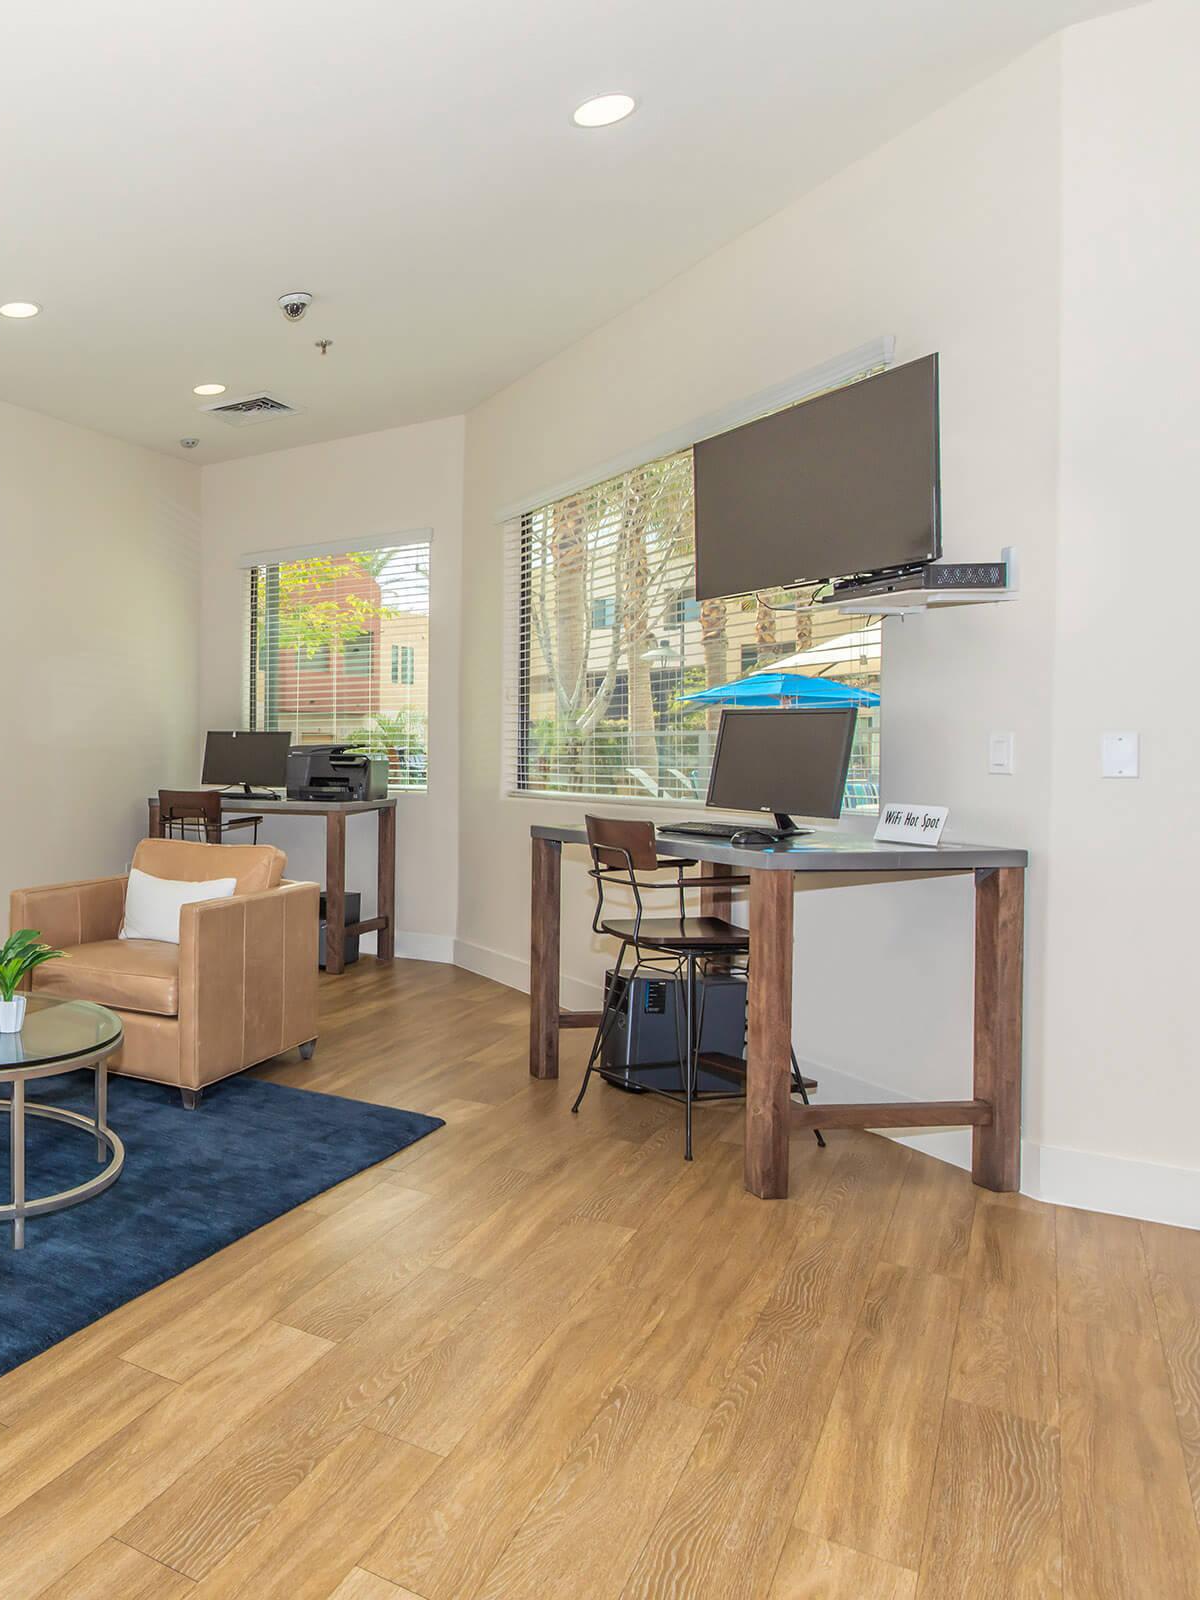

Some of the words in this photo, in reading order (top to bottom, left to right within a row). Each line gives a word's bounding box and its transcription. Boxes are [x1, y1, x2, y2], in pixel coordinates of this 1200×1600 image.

[884, 811, 903, 825] WiFi
[904, 812, 919, 827] Hot
[921, 813, 940, 832] Spot
